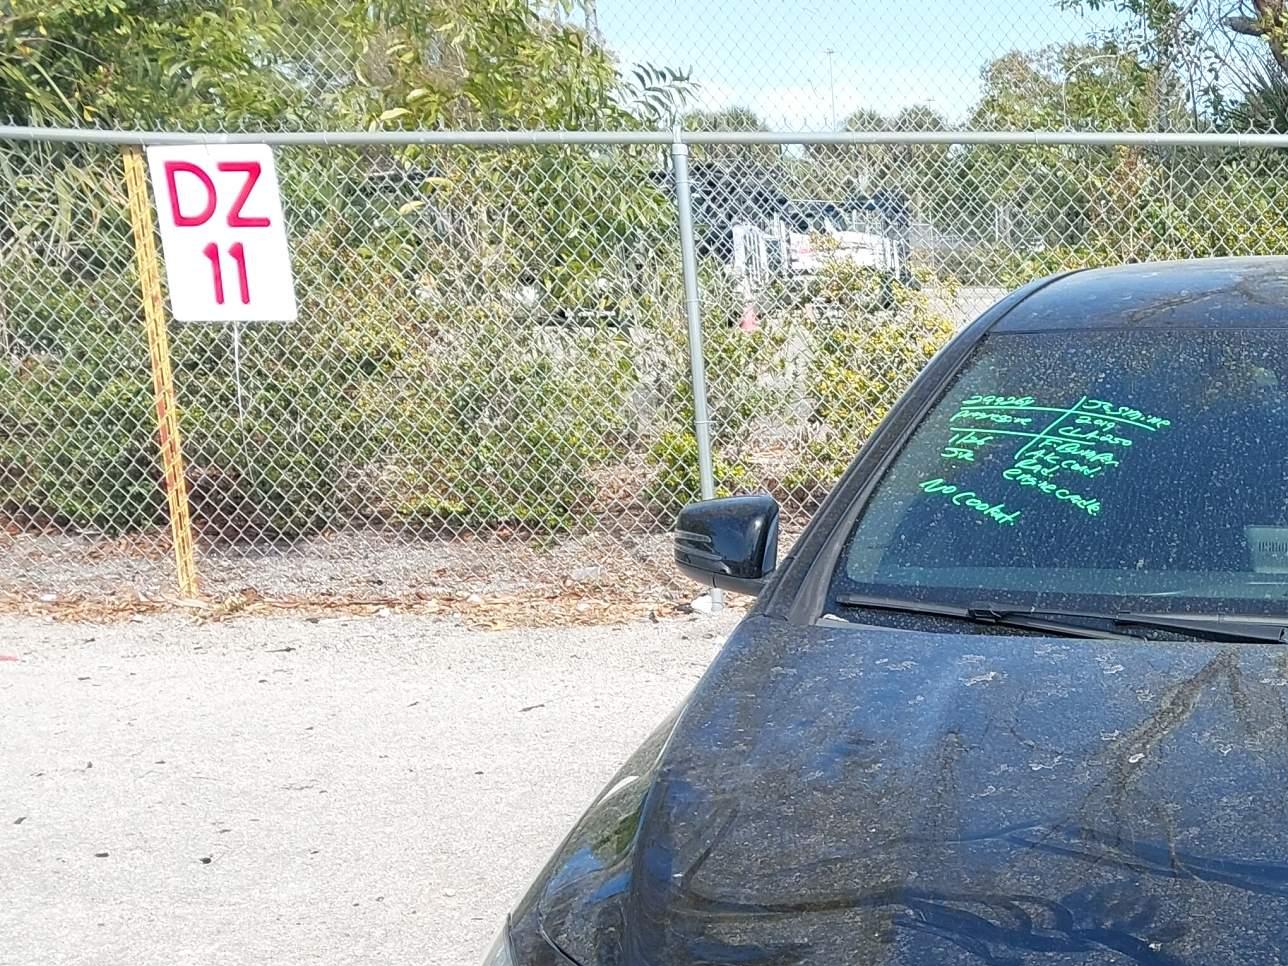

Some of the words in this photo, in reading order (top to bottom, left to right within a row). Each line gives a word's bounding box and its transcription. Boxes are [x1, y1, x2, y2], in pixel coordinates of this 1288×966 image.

[164, 161, 271, 228] DZ
[203, 242, 250, 305] 11
[1075, 415, 1115, 432] 2019
[918, 478, 957, 494] No
